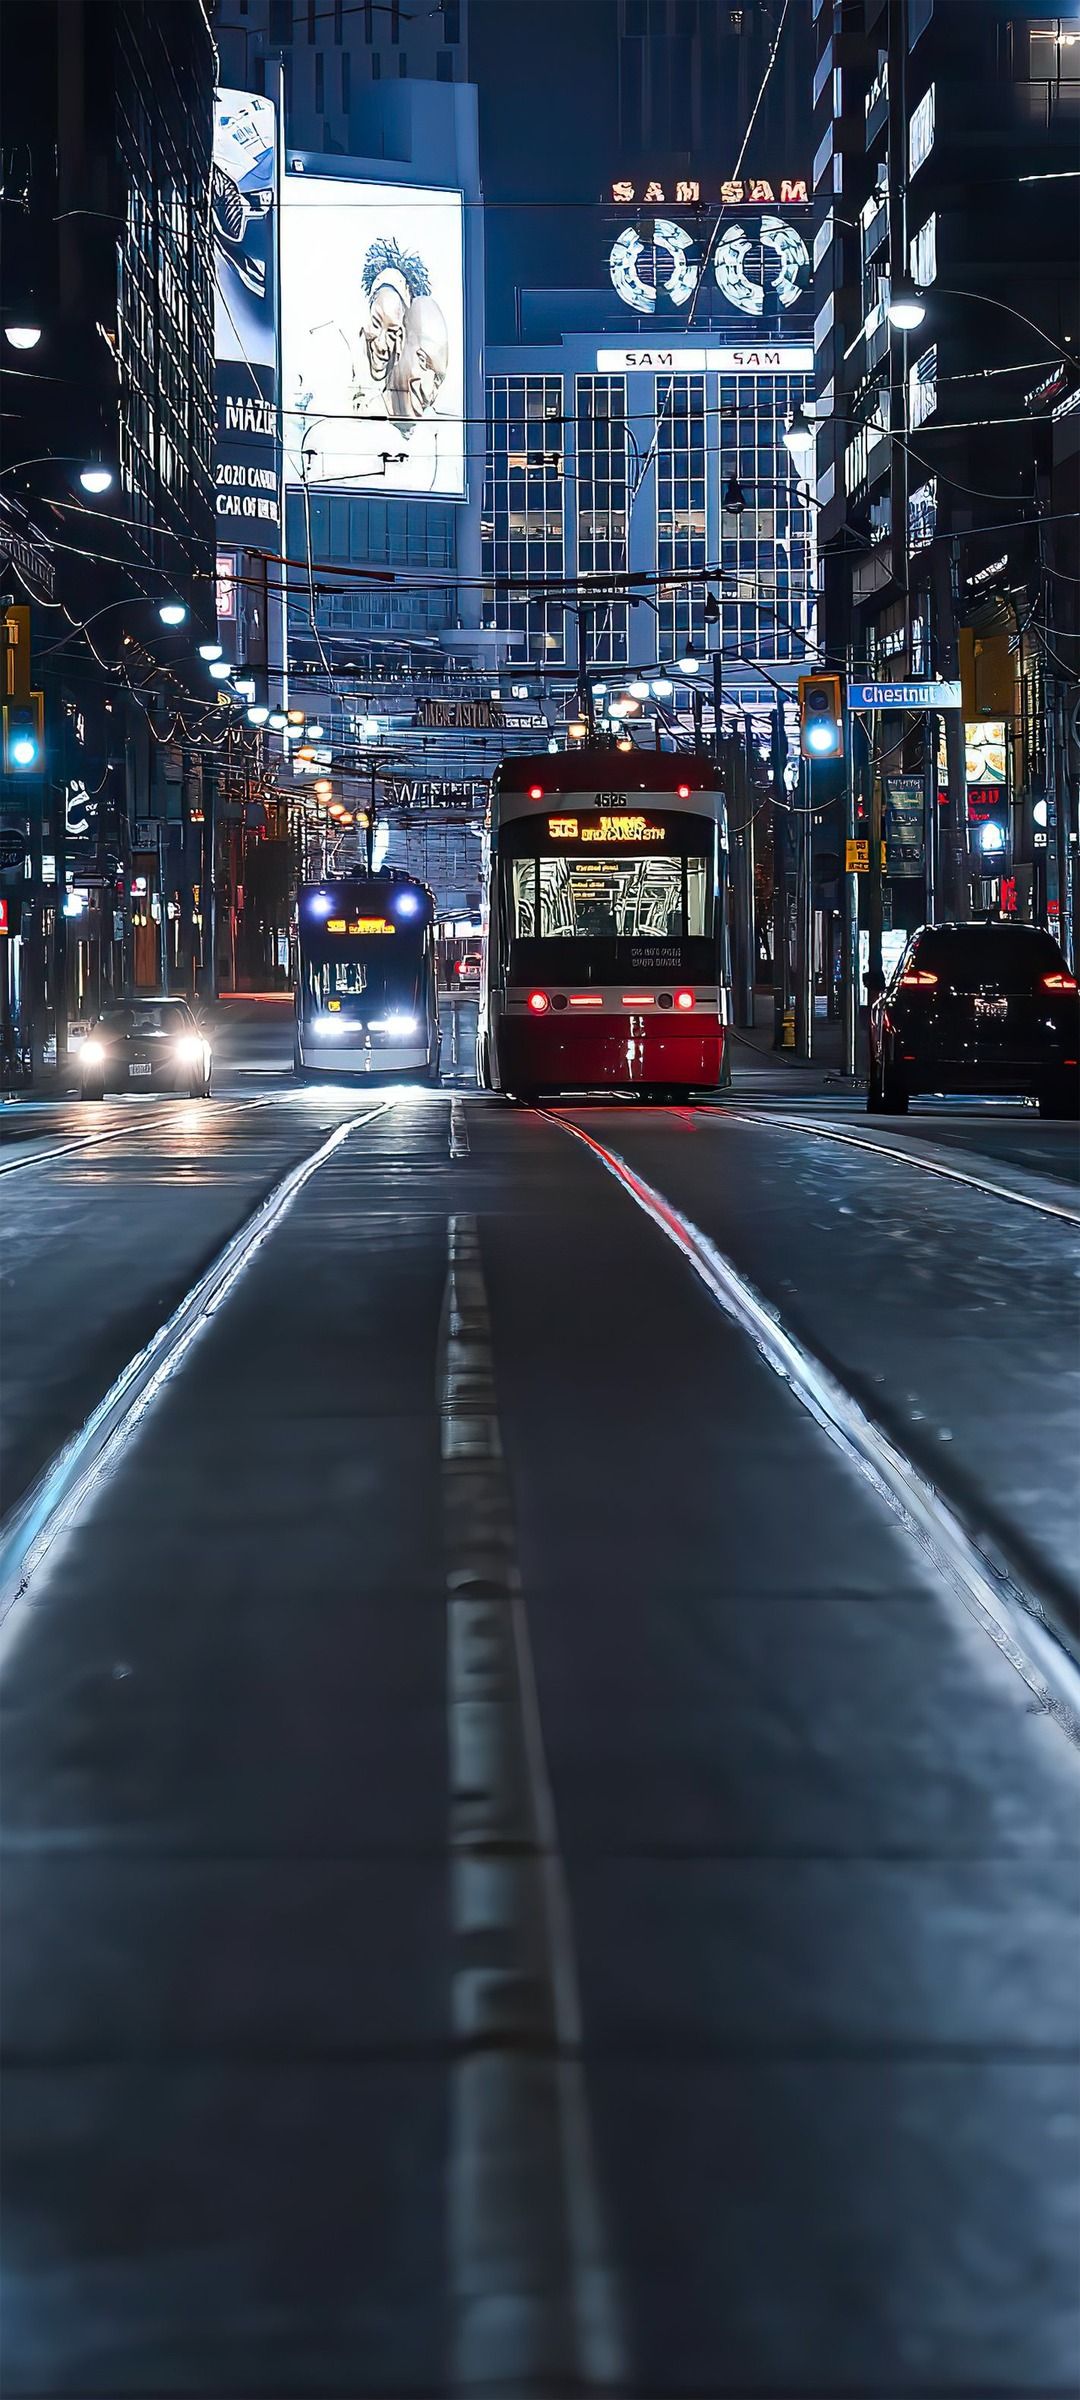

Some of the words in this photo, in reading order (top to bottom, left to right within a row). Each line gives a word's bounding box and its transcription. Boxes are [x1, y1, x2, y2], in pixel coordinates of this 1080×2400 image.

[612, 181, 700, 201] SAM
[720, 180, 809, 203] SAM
[625, 353, 672, 366] SAM
[733, 352, 780, 365] SAM
[216, 464, 246, 485] 2020
[216, 494, 241, 516] CAR
[862, 685, 935, 703] Chestnut
